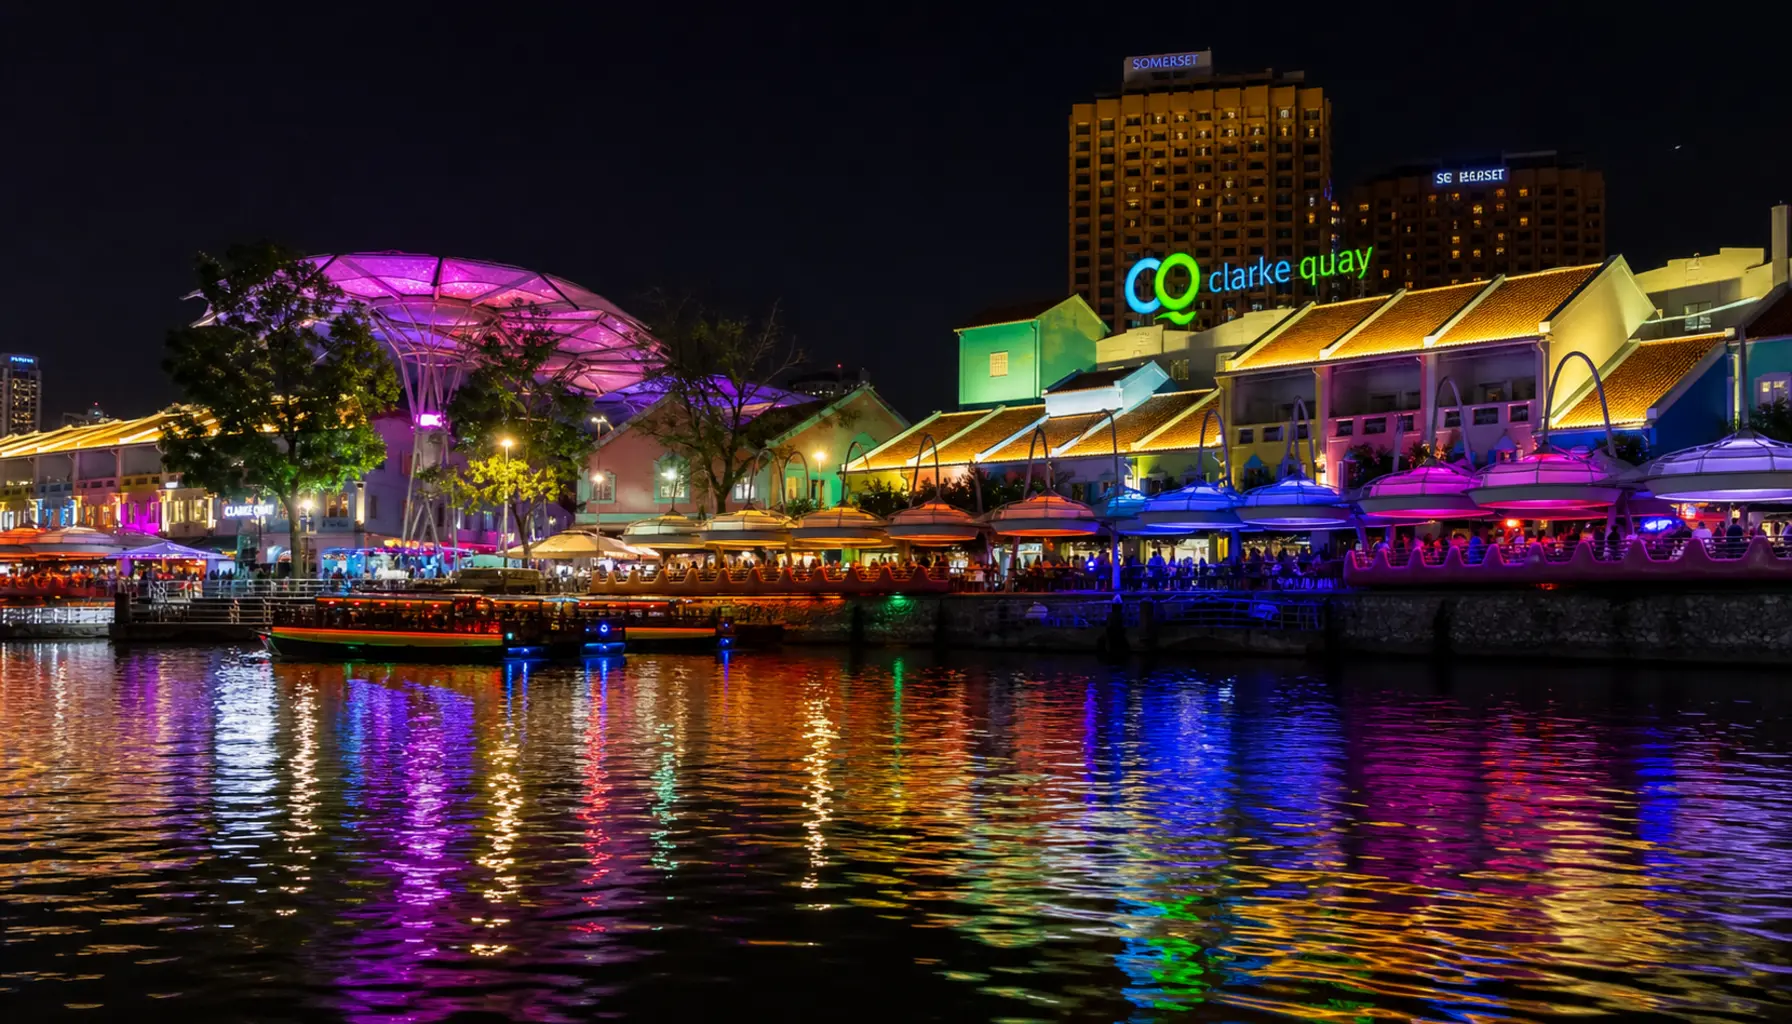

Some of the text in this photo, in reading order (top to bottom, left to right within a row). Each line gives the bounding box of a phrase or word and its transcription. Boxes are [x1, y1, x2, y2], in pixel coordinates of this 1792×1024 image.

[1132, 53, 1199, 70] SOMERSET
[1208, 255, 1291, 293] clarke
[1300, 246, 1373, 286] quay
